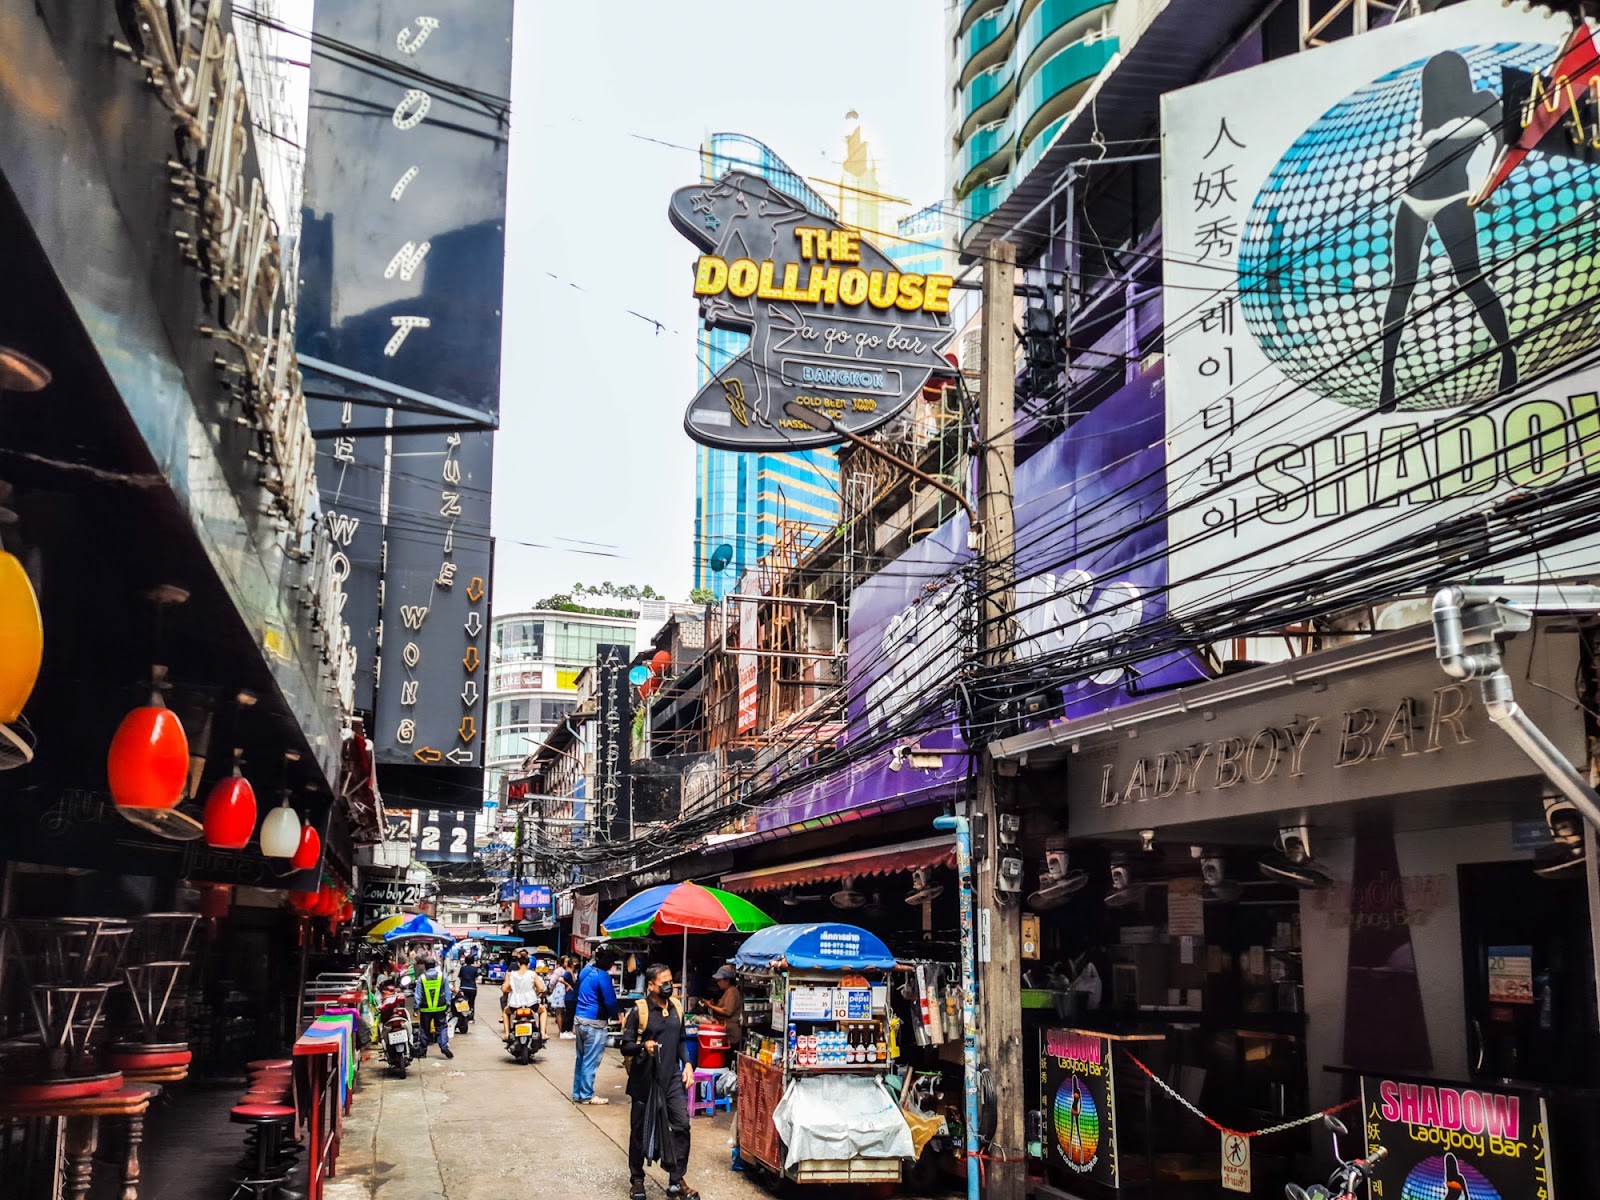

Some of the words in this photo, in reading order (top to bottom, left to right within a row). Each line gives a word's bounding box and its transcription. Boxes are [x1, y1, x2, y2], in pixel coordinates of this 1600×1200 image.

[384, 16, 440, 357] JOINT
[1192, 116, 1246, 263] 人妖秀
[794, 226, 861, 263] THE
[694, 254, 954, 313] DOLLHOUSE
[801, 325, 817, 340] a
[824, 325, 852, 353] go
[854, 330, 883, 358] go
[886, 325, 928, 355] bar
[803, 366, 884, 388] BANGKOK
[796, 396, 821, 408] COLD
[823, 398, 847, 409] BEER
[1197, 296, 1238, 540] 레이디보이
[397, 605, 428, 744] WONG
[1100, 715, 1323, 808] LADYBOY
[1334, 683, 1475, 769] BAR
[835, 1009, 846, 1018] 10
[849, 995, 869, 1003] pepsi
[1046, 1029, 1101, 1065] SHADOW
[1057, 1056, 1089, 1076] Ladyboy
[1089, 1061, 1104, 1077] Bar
[1380, 1080, 1520, 1141] SHADOW
[1408, 1121, 1485, 1157] Ladyboy
[1489, 1135, 1528, 1158] Bar
[1223, 1165, 1238, 1173] KEEP
[1238, 1168, 1249, 1176] OUT
